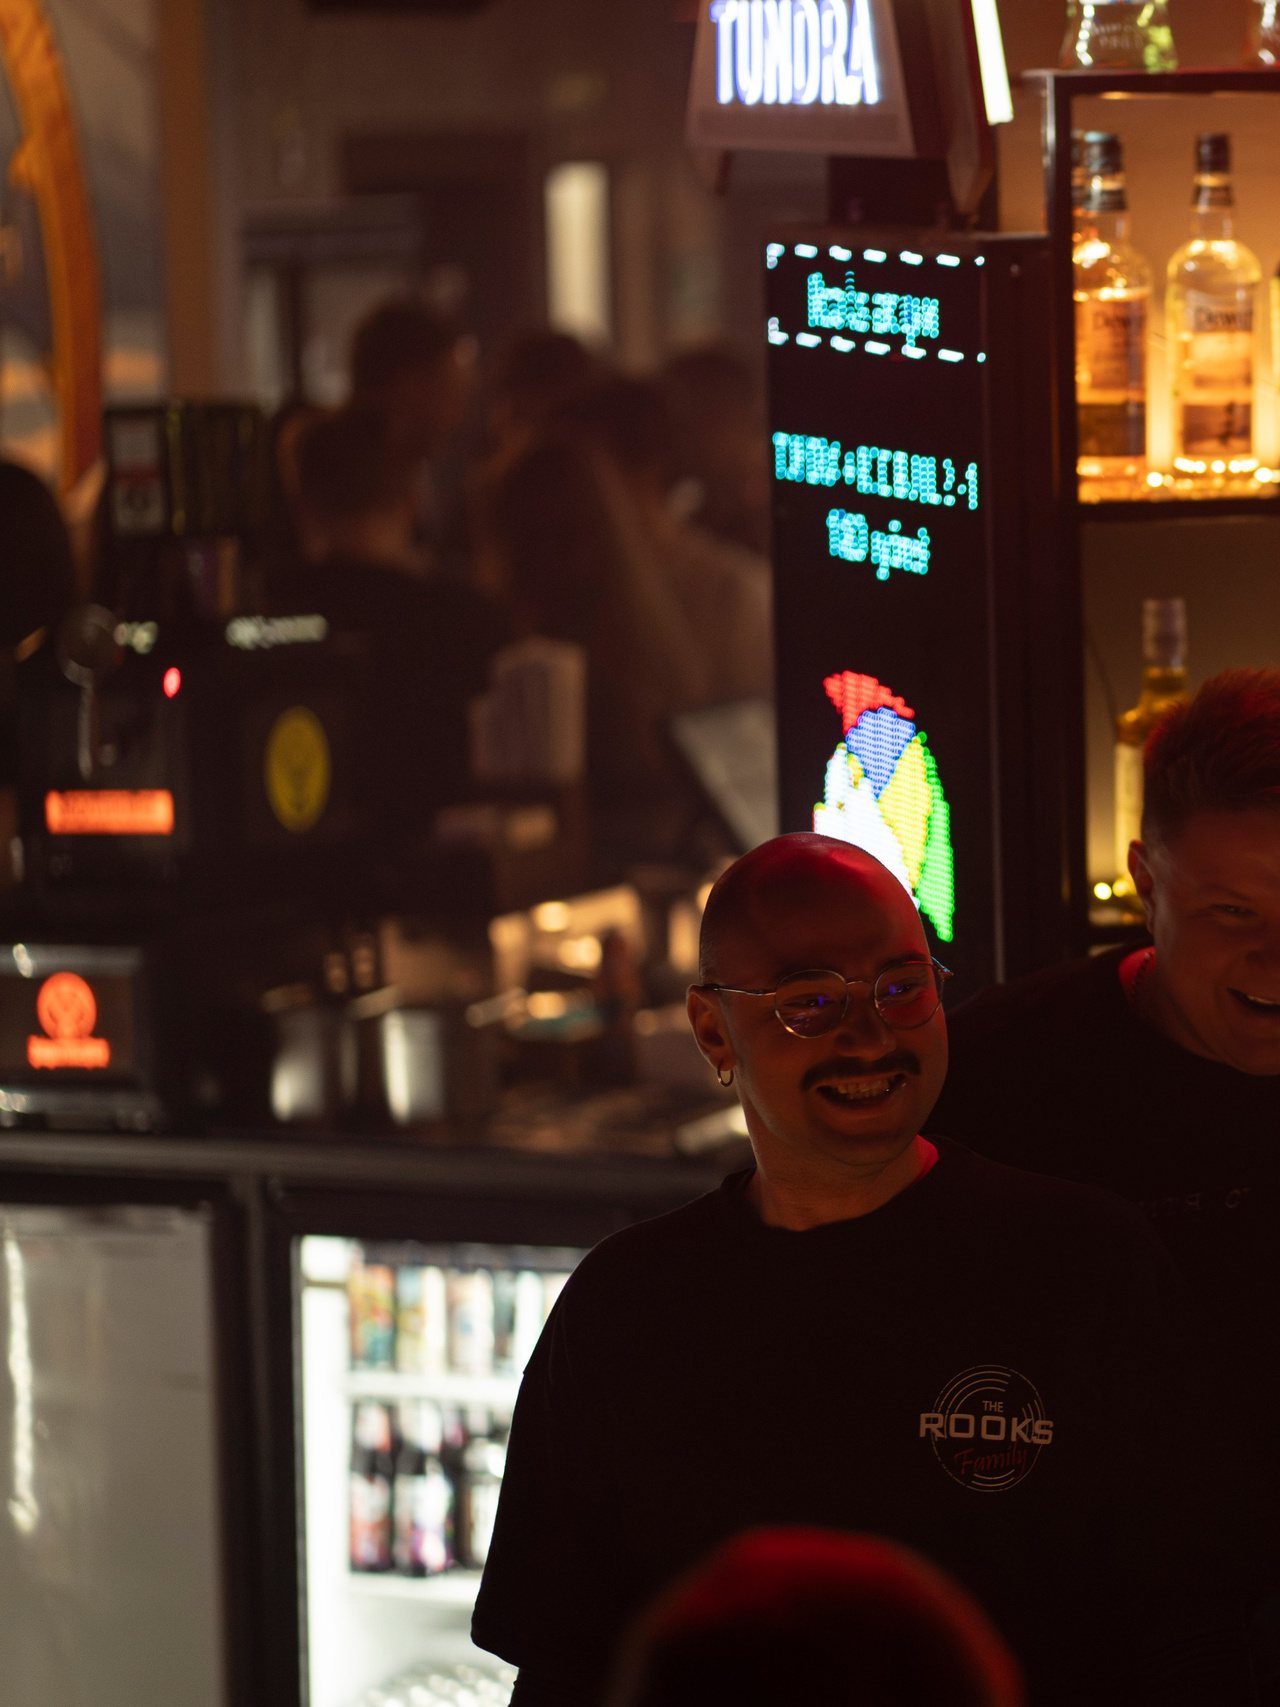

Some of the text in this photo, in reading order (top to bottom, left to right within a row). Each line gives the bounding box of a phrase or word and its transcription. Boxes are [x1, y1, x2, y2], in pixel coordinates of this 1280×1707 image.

[708, 0, 879, 105] TUNDRA
[982, 1400, 1004, 1412] THE
[919, 1413, 1054, 1444] ROOKS
[953, 1439, 1027, 1478] Family
